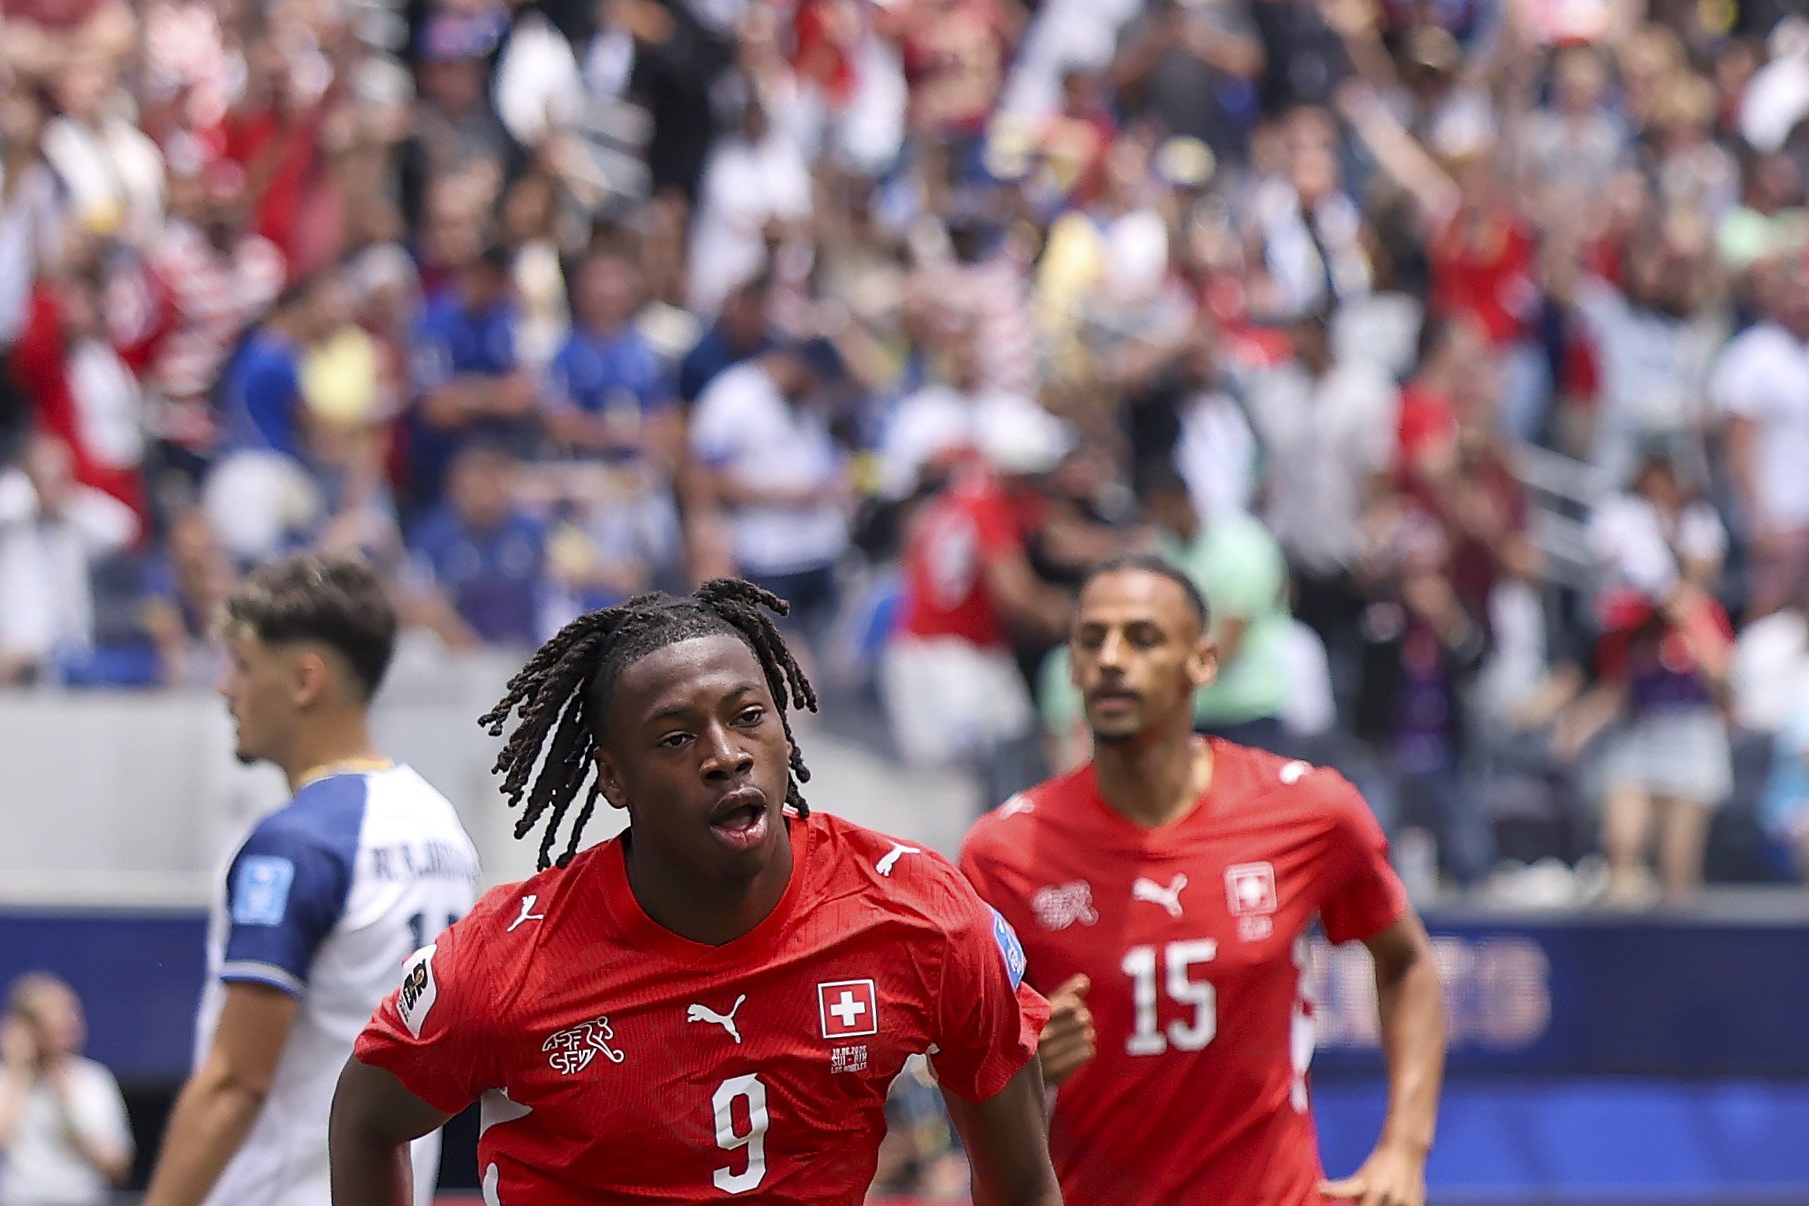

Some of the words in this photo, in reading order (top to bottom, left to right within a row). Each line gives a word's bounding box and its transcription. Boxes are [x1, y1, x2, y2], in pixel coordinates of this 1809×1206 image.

[1120, 938, 1218, 1056] 15
[831, 1055, 846, 1067] SUI
[711, 1072, 770, 1194] 9
